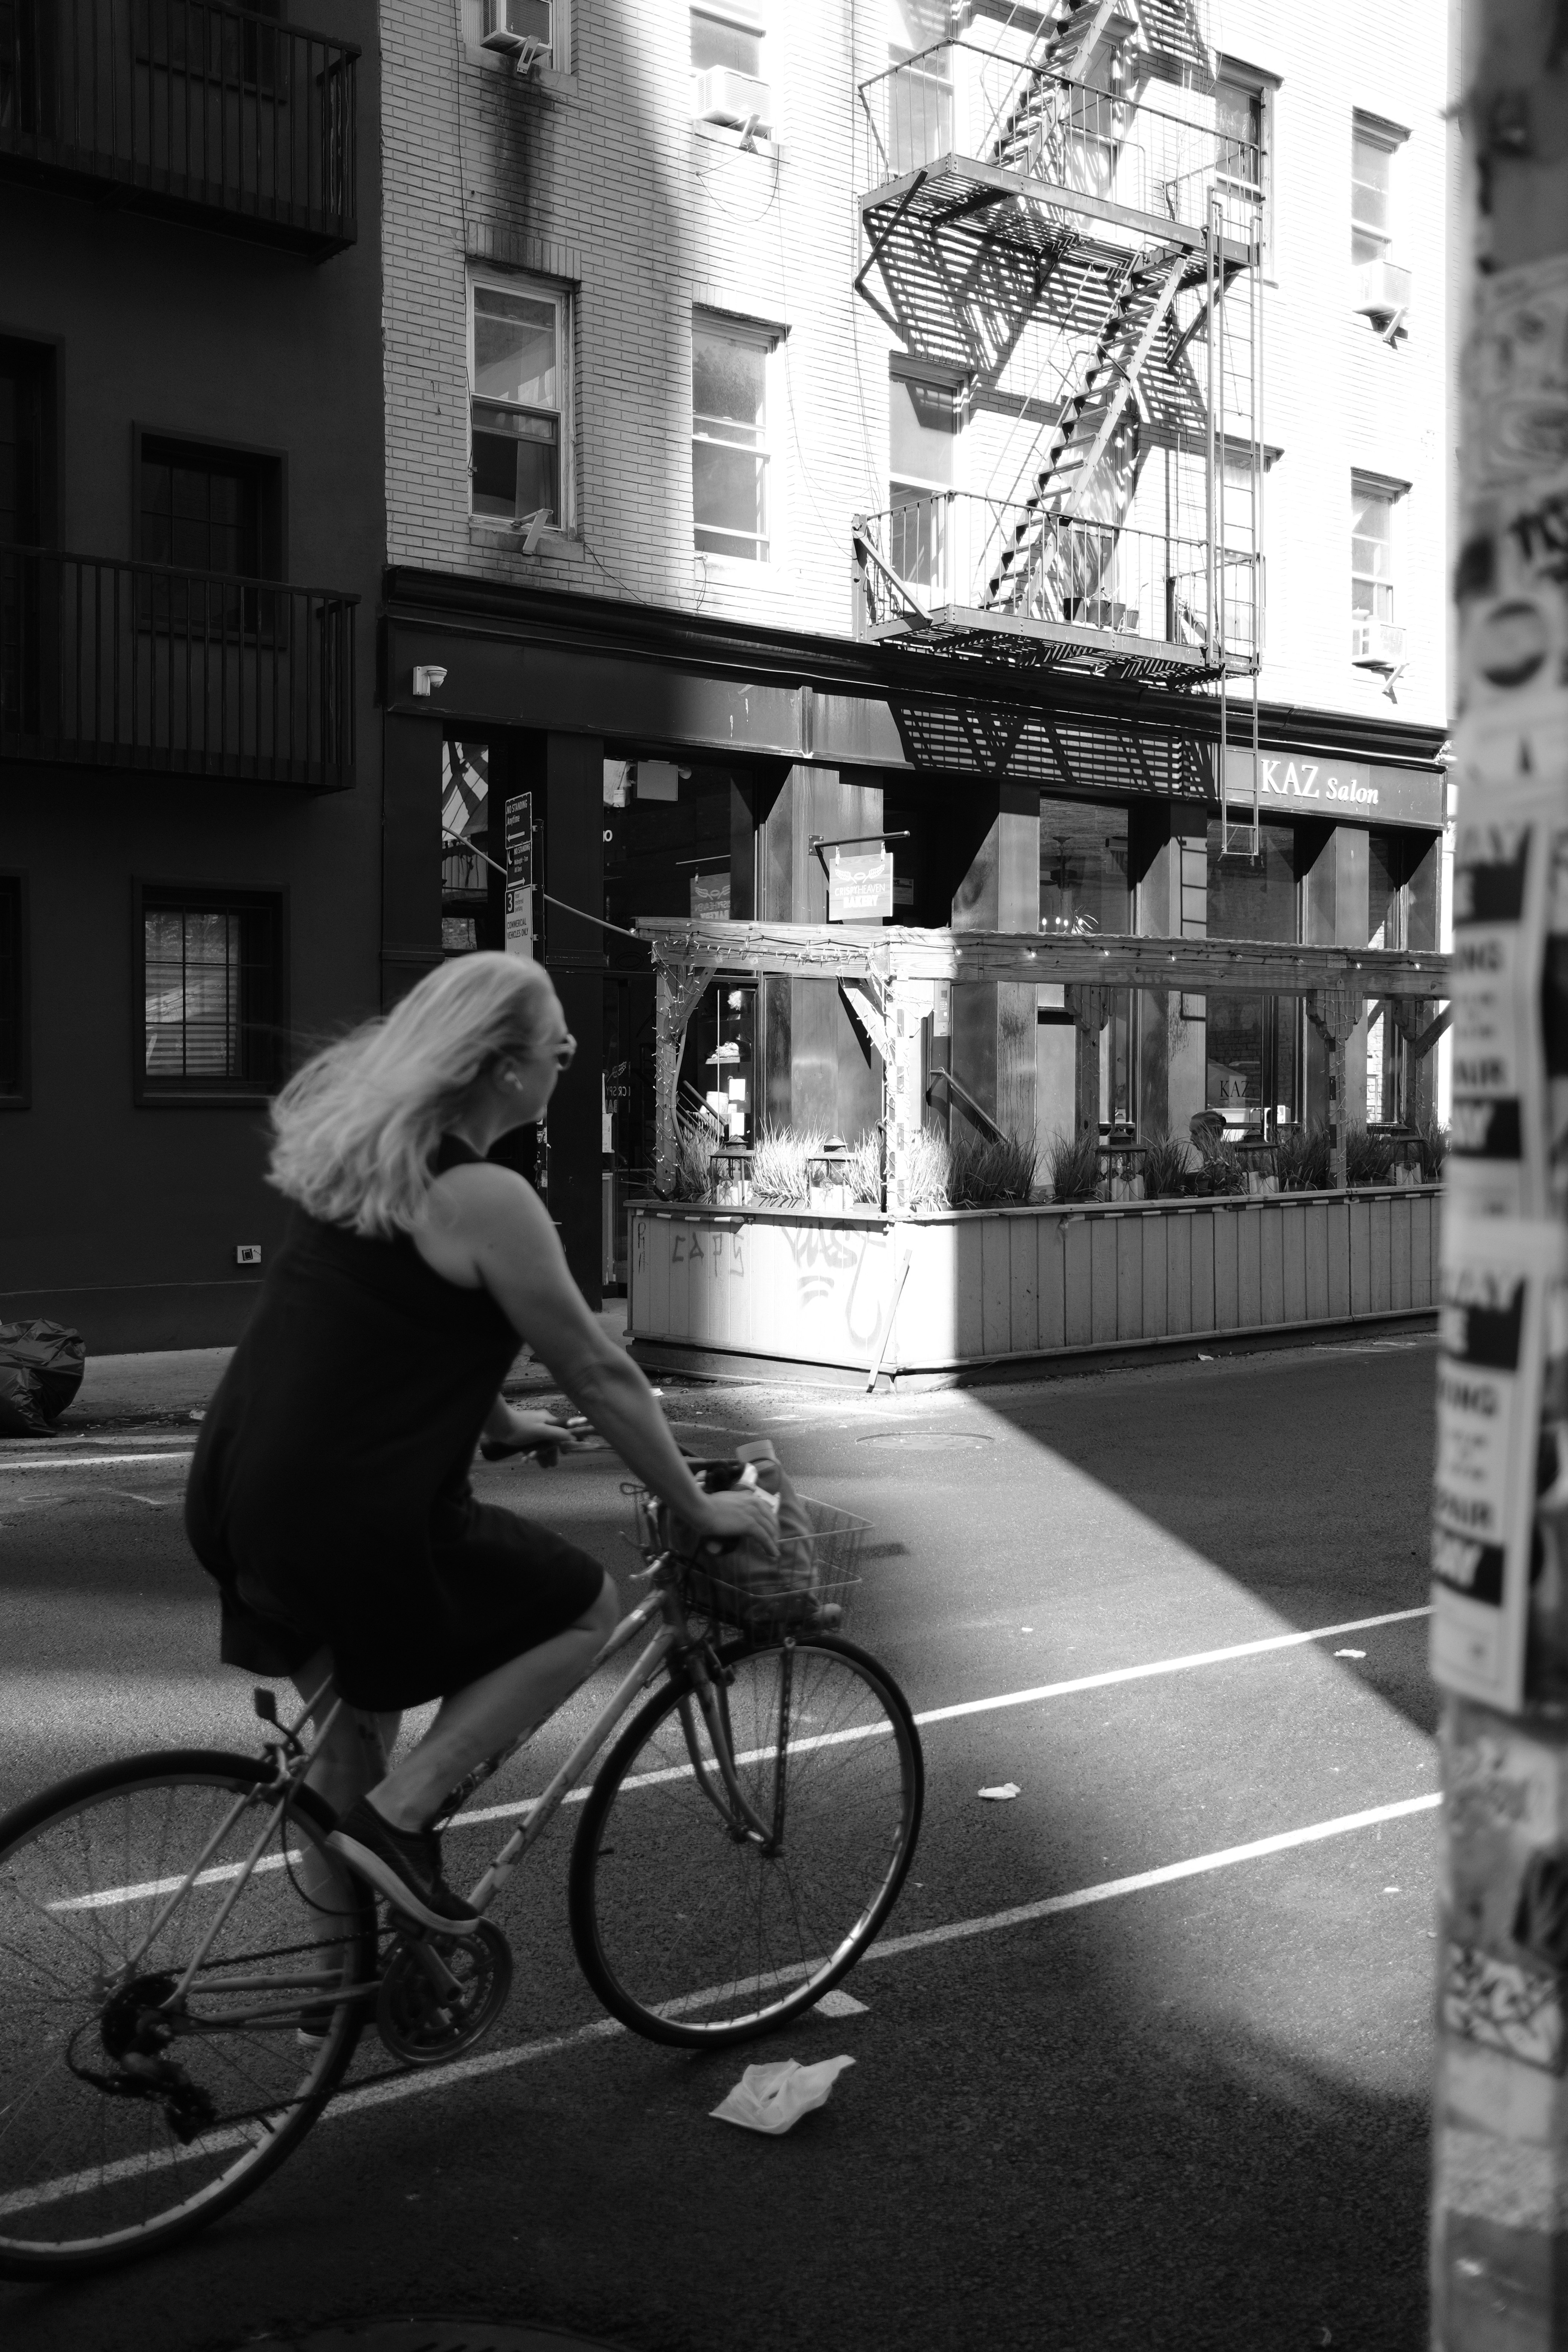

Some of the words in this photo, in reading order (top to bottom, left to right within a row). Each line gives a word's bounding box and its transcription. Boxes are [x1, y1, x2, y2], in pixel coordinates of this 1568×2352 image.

[1261, 759, 1320, 798] KAZ
[1326, 778, 1378, 805] Salon
[507, 805, 511, 814] NO
[512, 799, 527, 813] STANDING
[507, 815, 520, 826] Anytime
[518, 843, 530, 854] STANDING
[508, 893, 513, 912] 3
[843, 894, 879, 908] BAKERY
[507, 917, 527, 929] COMMERCIAL
[507, 929, 521, 939] VEHICLES
[1220, 1080, 1250, 1097] KAZ
